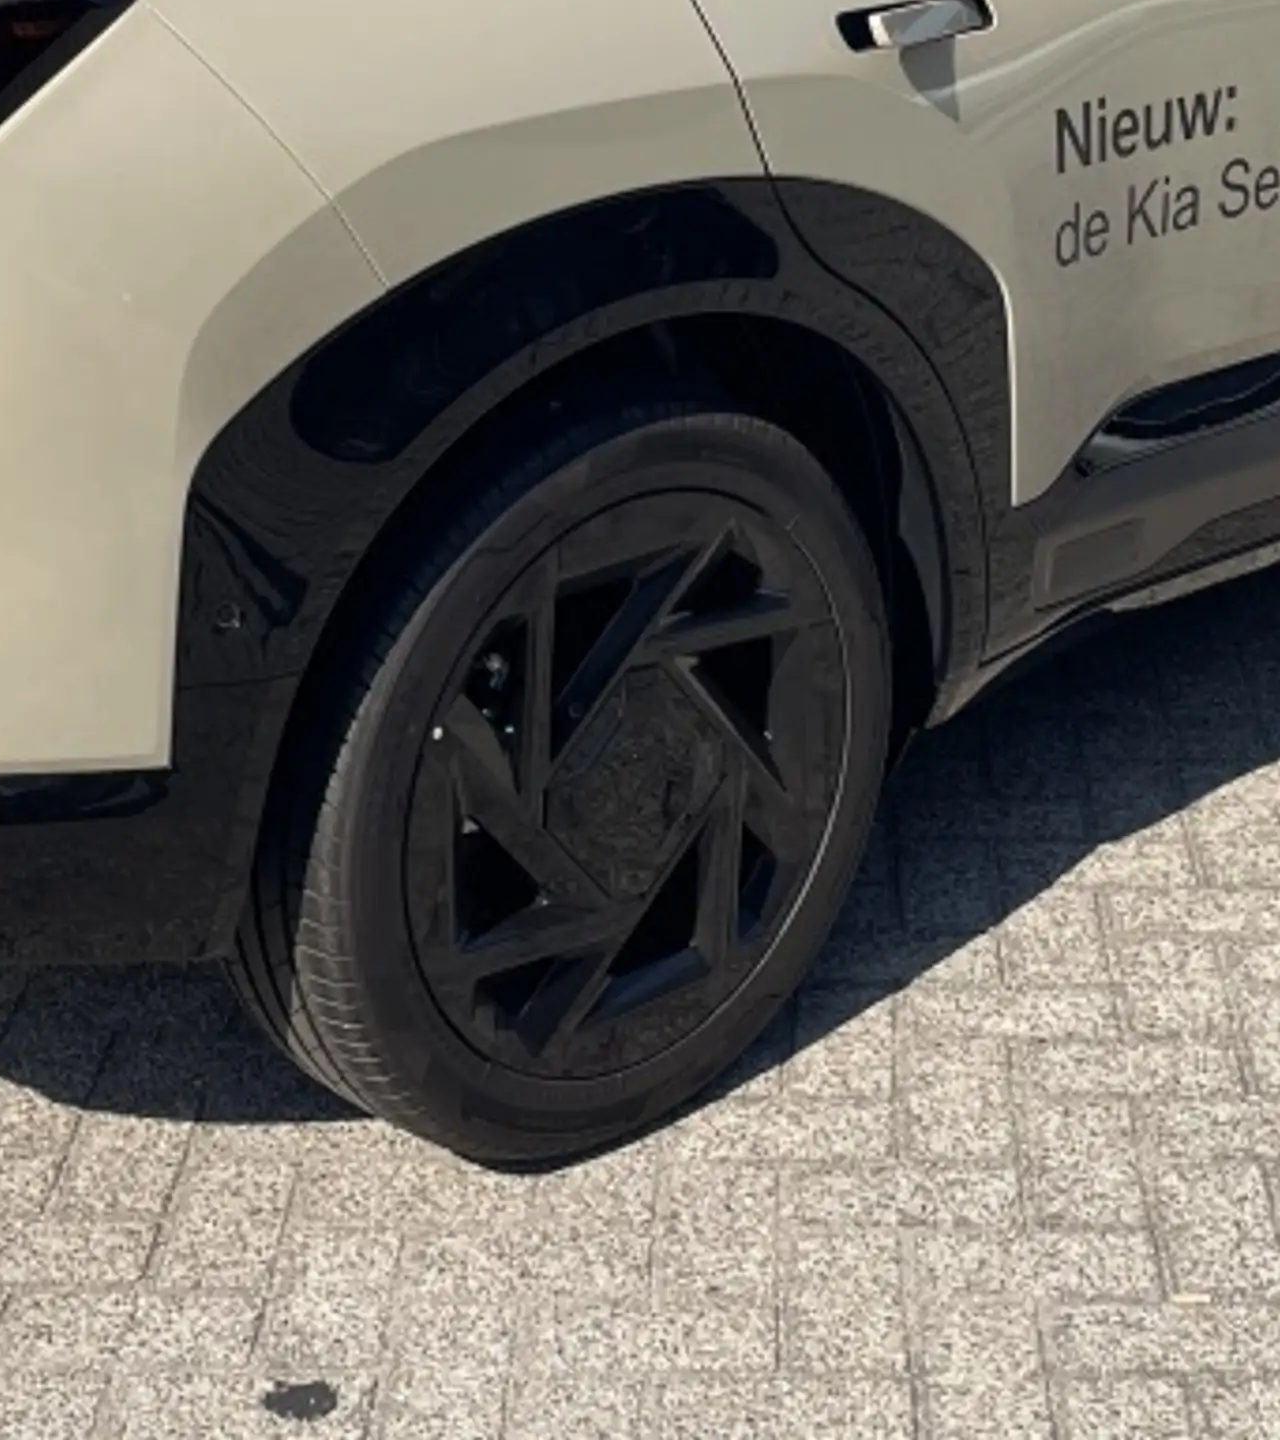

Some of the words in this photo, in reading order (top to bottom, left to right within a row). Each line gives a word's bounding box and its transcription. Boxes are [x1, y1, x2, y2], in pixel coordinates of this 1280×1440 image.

[1055, 85, 1237, 174] Nieuw:
[1055, 202, 1110, 267] de
[1126, 176, 1201, 245] Kia
